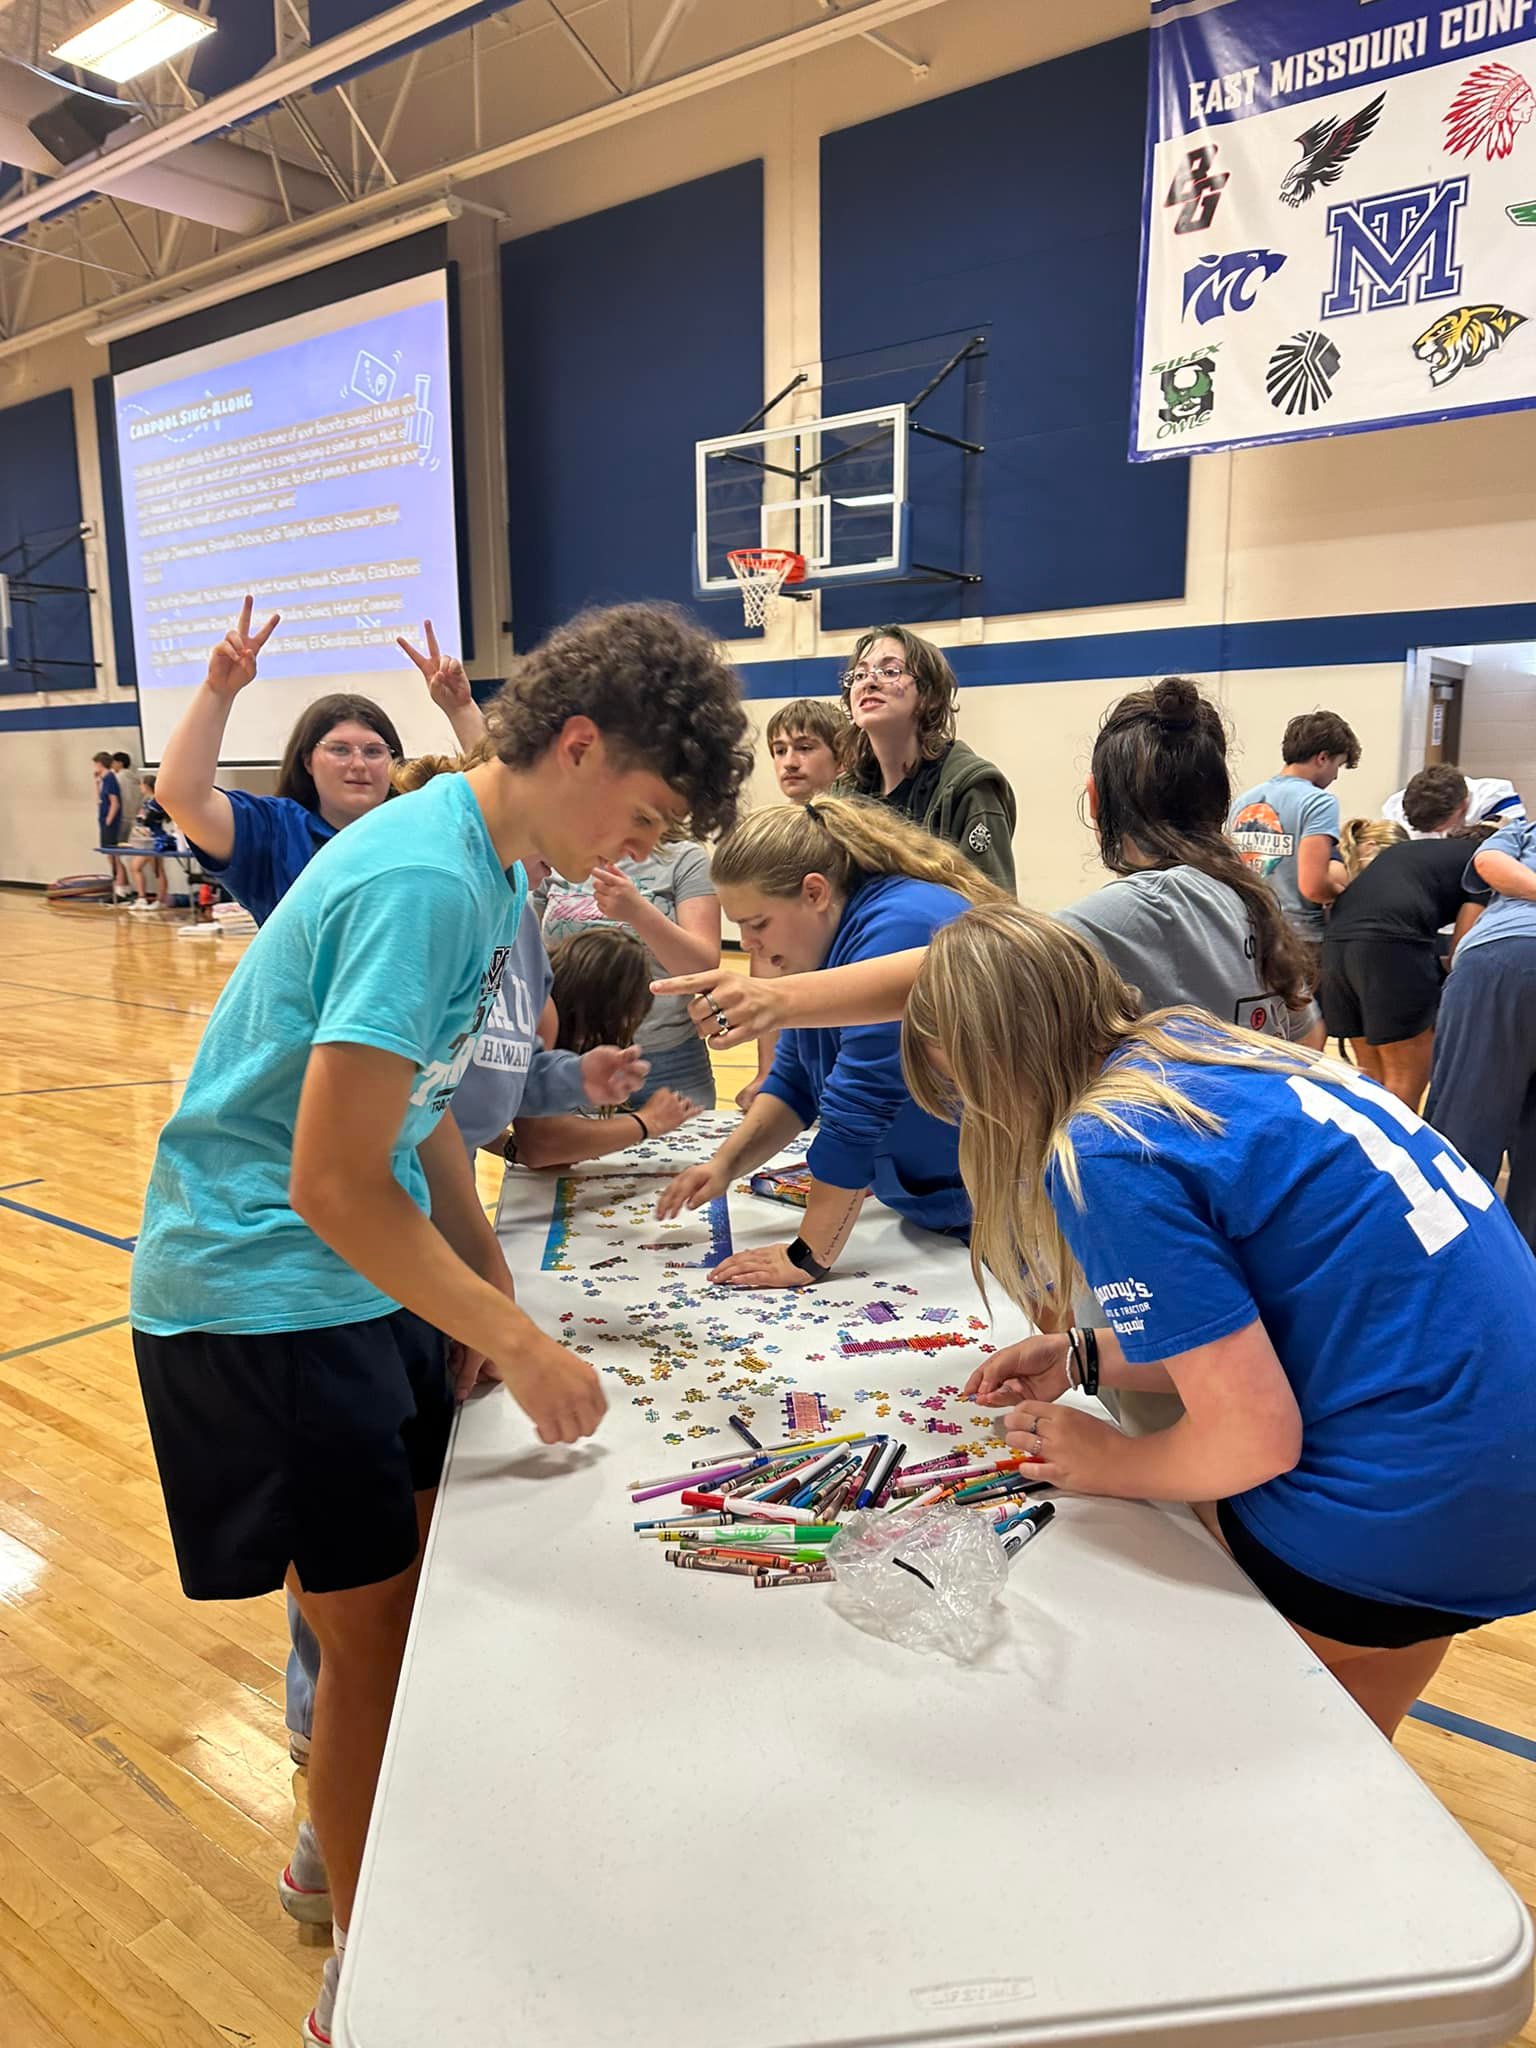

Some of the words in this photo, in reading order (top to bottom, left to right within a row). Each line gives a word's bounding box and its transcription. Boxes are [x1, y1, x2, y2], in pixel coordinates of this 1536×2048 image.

[1188, 71, 1261, 121] EAST
[1270, 16, 1428, 94] MISSOURI
[1440, 0, 1536, 49] CONF
[1149, 341, 1224, 375] SILEX
[130, 414, 179, 440] CARPOOL
[1120, 1302, 1151, 1316] TRACTOR
